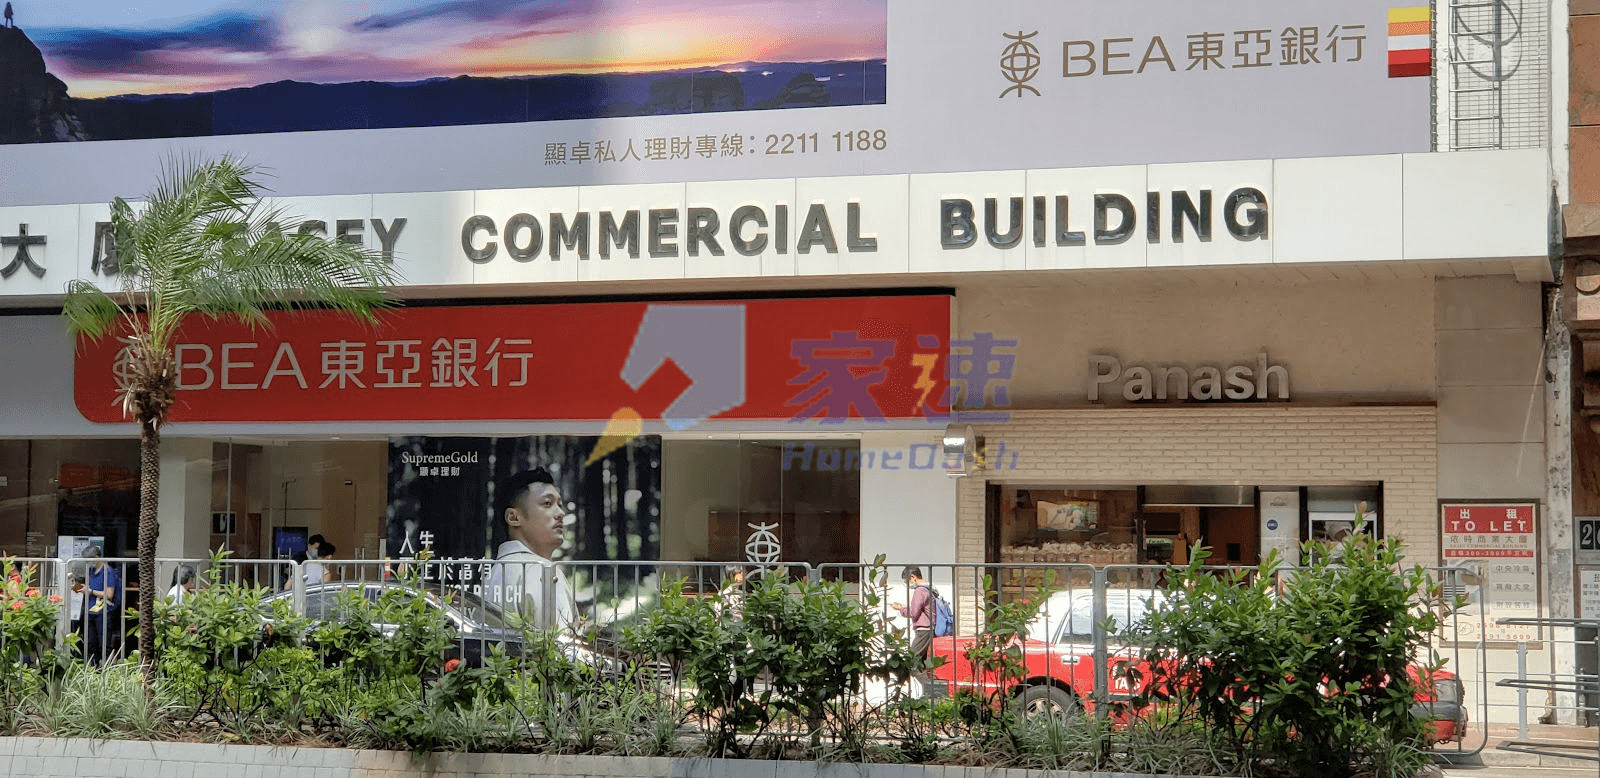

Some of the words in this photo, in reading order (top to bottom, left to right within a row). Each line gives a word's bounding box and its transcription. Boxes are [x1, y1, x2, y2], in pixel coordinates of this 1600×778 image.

[1062, 35, 1177, 78] BEA
[1185, 24, 1367, 71] 東亞銀行
[764, 133, 819, 155] 2211
[832, 129, 887, 151] 1188
[461, 202, 878, 265] COMMERCIAL
[940, 186, 1269, 250] BUILDING
[174, 342, 308, 391] BEA
[318, 337, 534, 390] 東亞銀行
[1087, 352, 1291, 402] Panash
[401, 451, 479, 466] SupremeGold
[419, 466, 460, 477] 顯卓理財
[1460, 508, 1518, 519] 出租
[1451, 520, 1476, 532] TO
[1489, 520, 1527, 532] LET
[399, 530, 435, 554] 人生
[1450, 535, 1528, 544] 依時商業大廈
